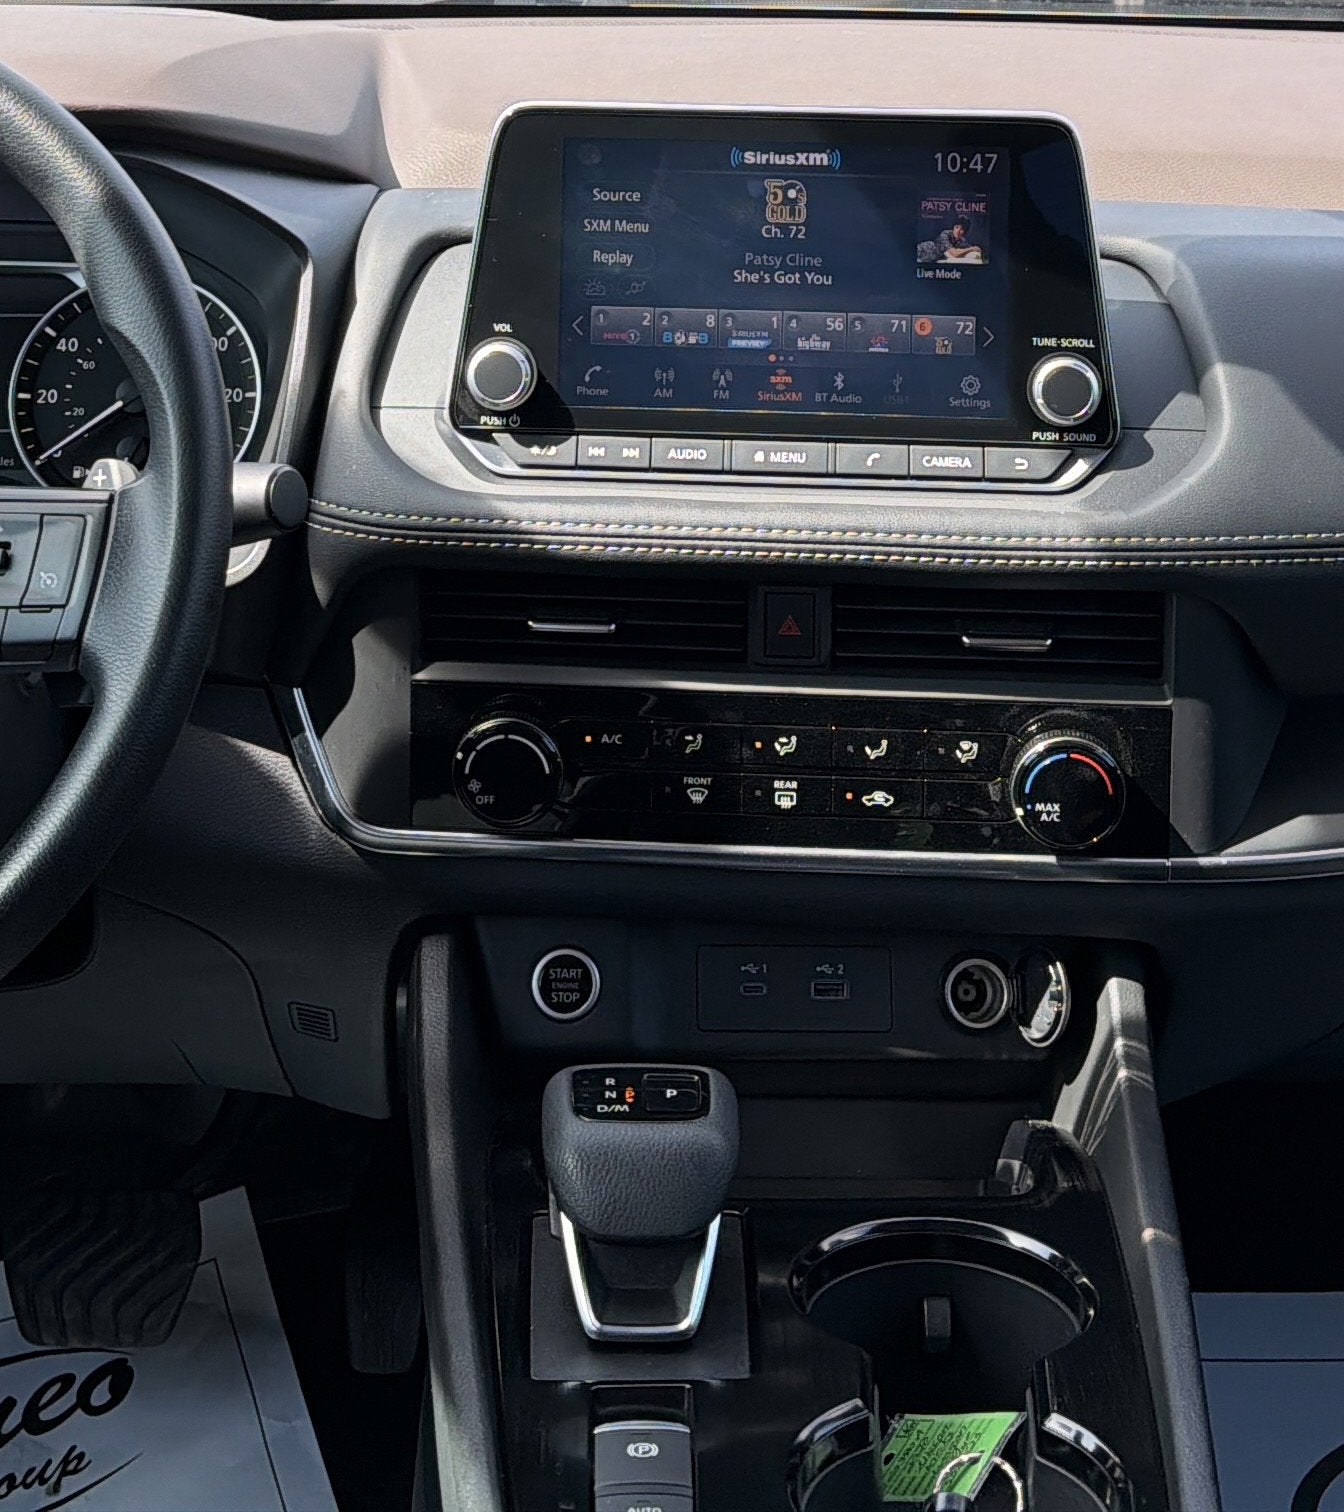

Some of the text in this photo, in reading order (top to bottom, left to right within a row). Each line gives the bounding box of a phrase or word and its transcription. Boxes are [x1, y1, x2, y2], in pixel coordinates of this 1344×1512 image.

[933, 151, 998, 174] 10:47
[592, 187, 641, 202] Source
[920, 200, 988, 213] PATSY CLINE
[766, 204, 806, 223] GOLD
[583, 218, 650, 233] SXM Menu
[761, 225, 806, 239] Ch. 72
[592, 249, 634, 267] Replay
[744, 252, 824, 269] Patsy Cline
[733, 269, 833, 286] She's Got You
[916, 267, 962, 280] Live Mode
[641, 312, 652, 326] 2
[705, 314, 716, 328] 8
[825, 317, 844, 332] 56
[493, 323, 513, 333] VOL
[890, 319, 907, 333] 71
[955, 321, 974, 335] 72
[56, 337, 79, 353] 40
[82, 360, 96, 370] 60
[36, 389, 58, 404] 20
[576, 386, 609, 397] Phone
[653, 388, 673, 399] AM
[713, 390, 730, 400] FM
[757, 391, 803, 402] SiriusXM
[815, 392, 863, 405] BT Audio
[948, 396, 992, 410] Settings
[71, 407, 85, 417] 20
[479, 415, 507, 426] PUSH
[1031, 431, 1097, 442] PUSH SOUND
[667, 448, 708, 460] AUDIO
[768, 449, 807, 465] MENU
[921, 452, 972, 470] CAMERA
[600, 733, 623, 746] A/C
[682, 776, 712, 786] FRONT
[773, 779, 798, 790] REAR
[475, 795, 496, 806] OFF
[1034, 802, 1061, 812] MAX
[1039, 812, 1062, 822] A/C
[548, 968, 584, 980] START
[551, 981, 579, 990] ENGINE
[550, 991, 581, 1004] STOP
[605, 1090, 617, 1099] N
[665, 1089, 678, 1099] P
[596, 1104, 630, 1113] D/M
